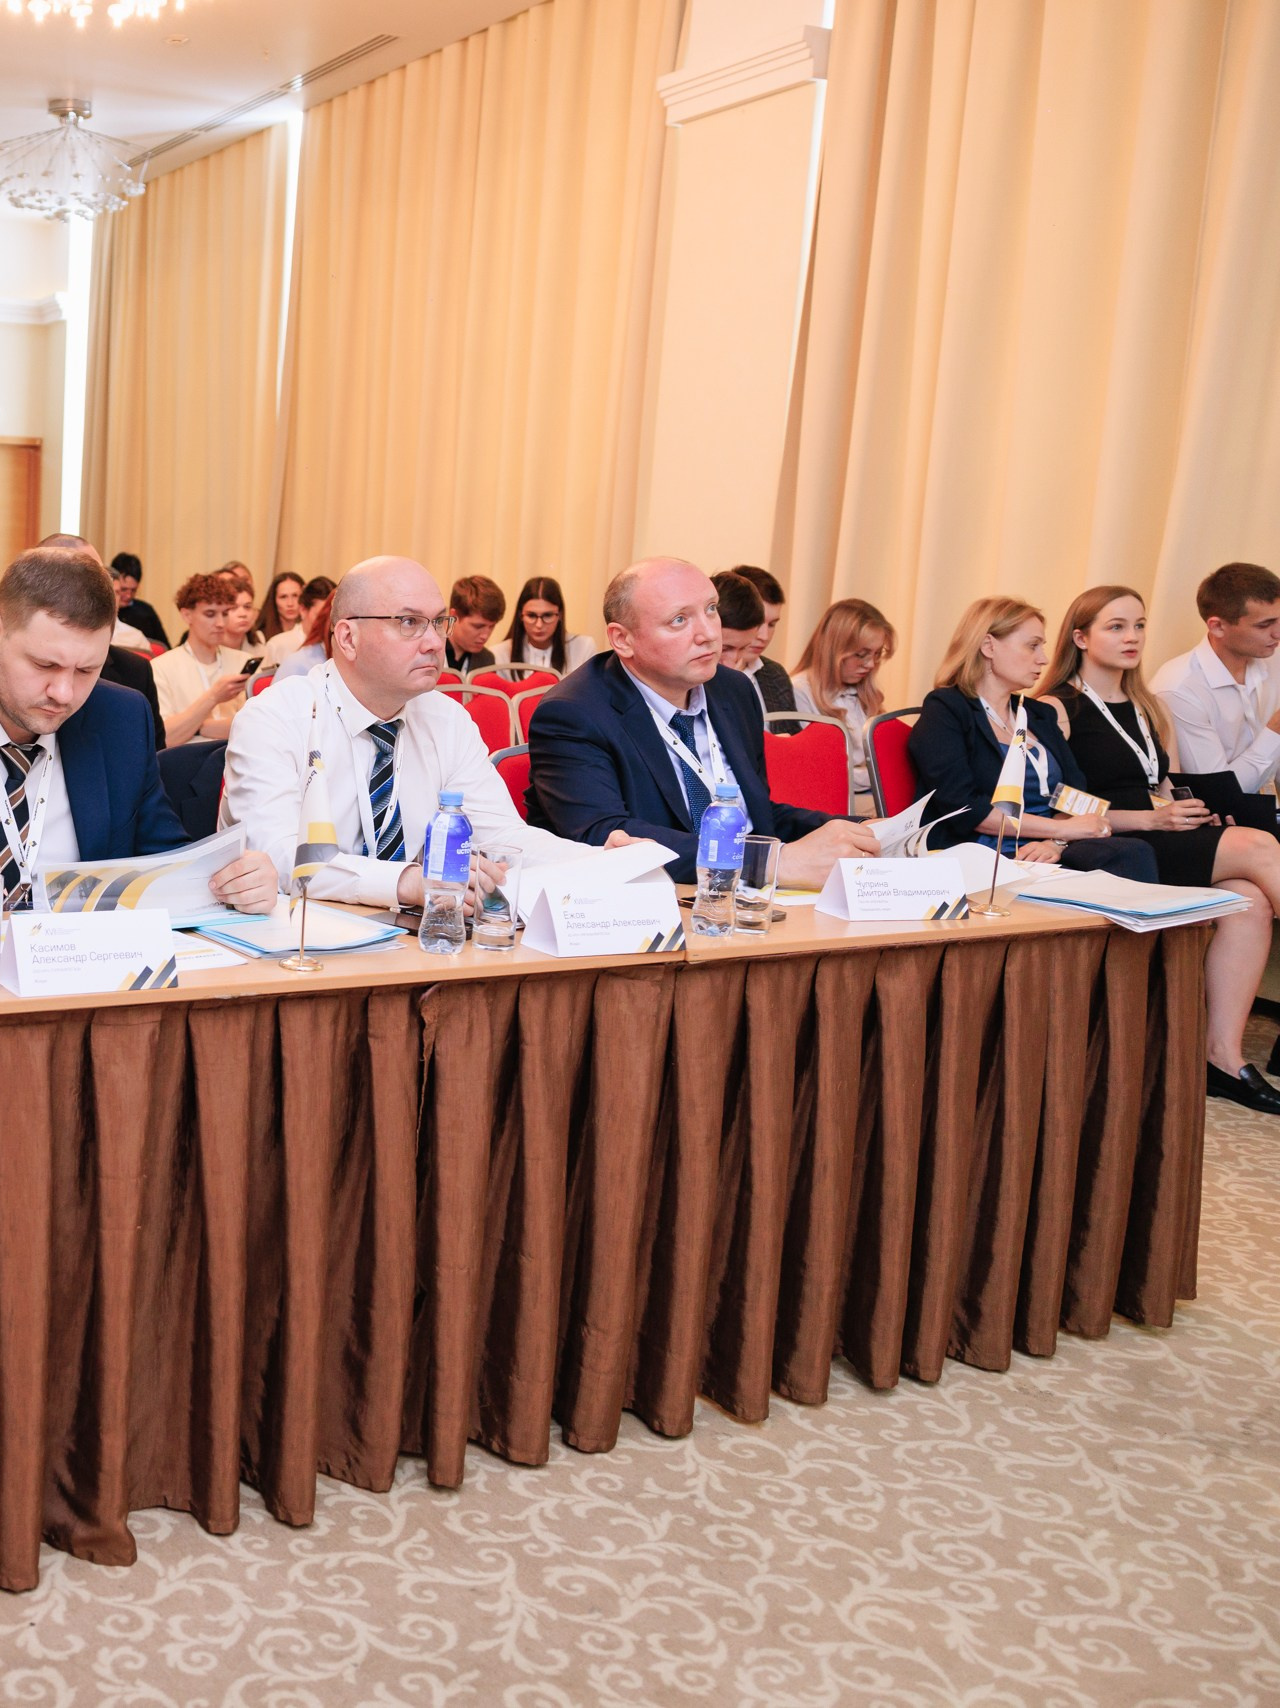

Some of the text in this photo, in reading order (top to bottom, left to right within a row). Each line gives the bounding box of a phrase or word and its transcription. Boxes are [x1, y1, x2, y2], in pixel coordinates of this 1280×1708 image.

[855, 881, 889, 889] Чуприна
[857, 888, 950, 898] Дмитрий Владимирович
[563, 910, 586, 920] Ежов
[566, 918, 662, 930] Александр Алексеевич
[29, 943, 77, 954] Касимов
[32, 951, 144, 965] Александр Сергеевич
